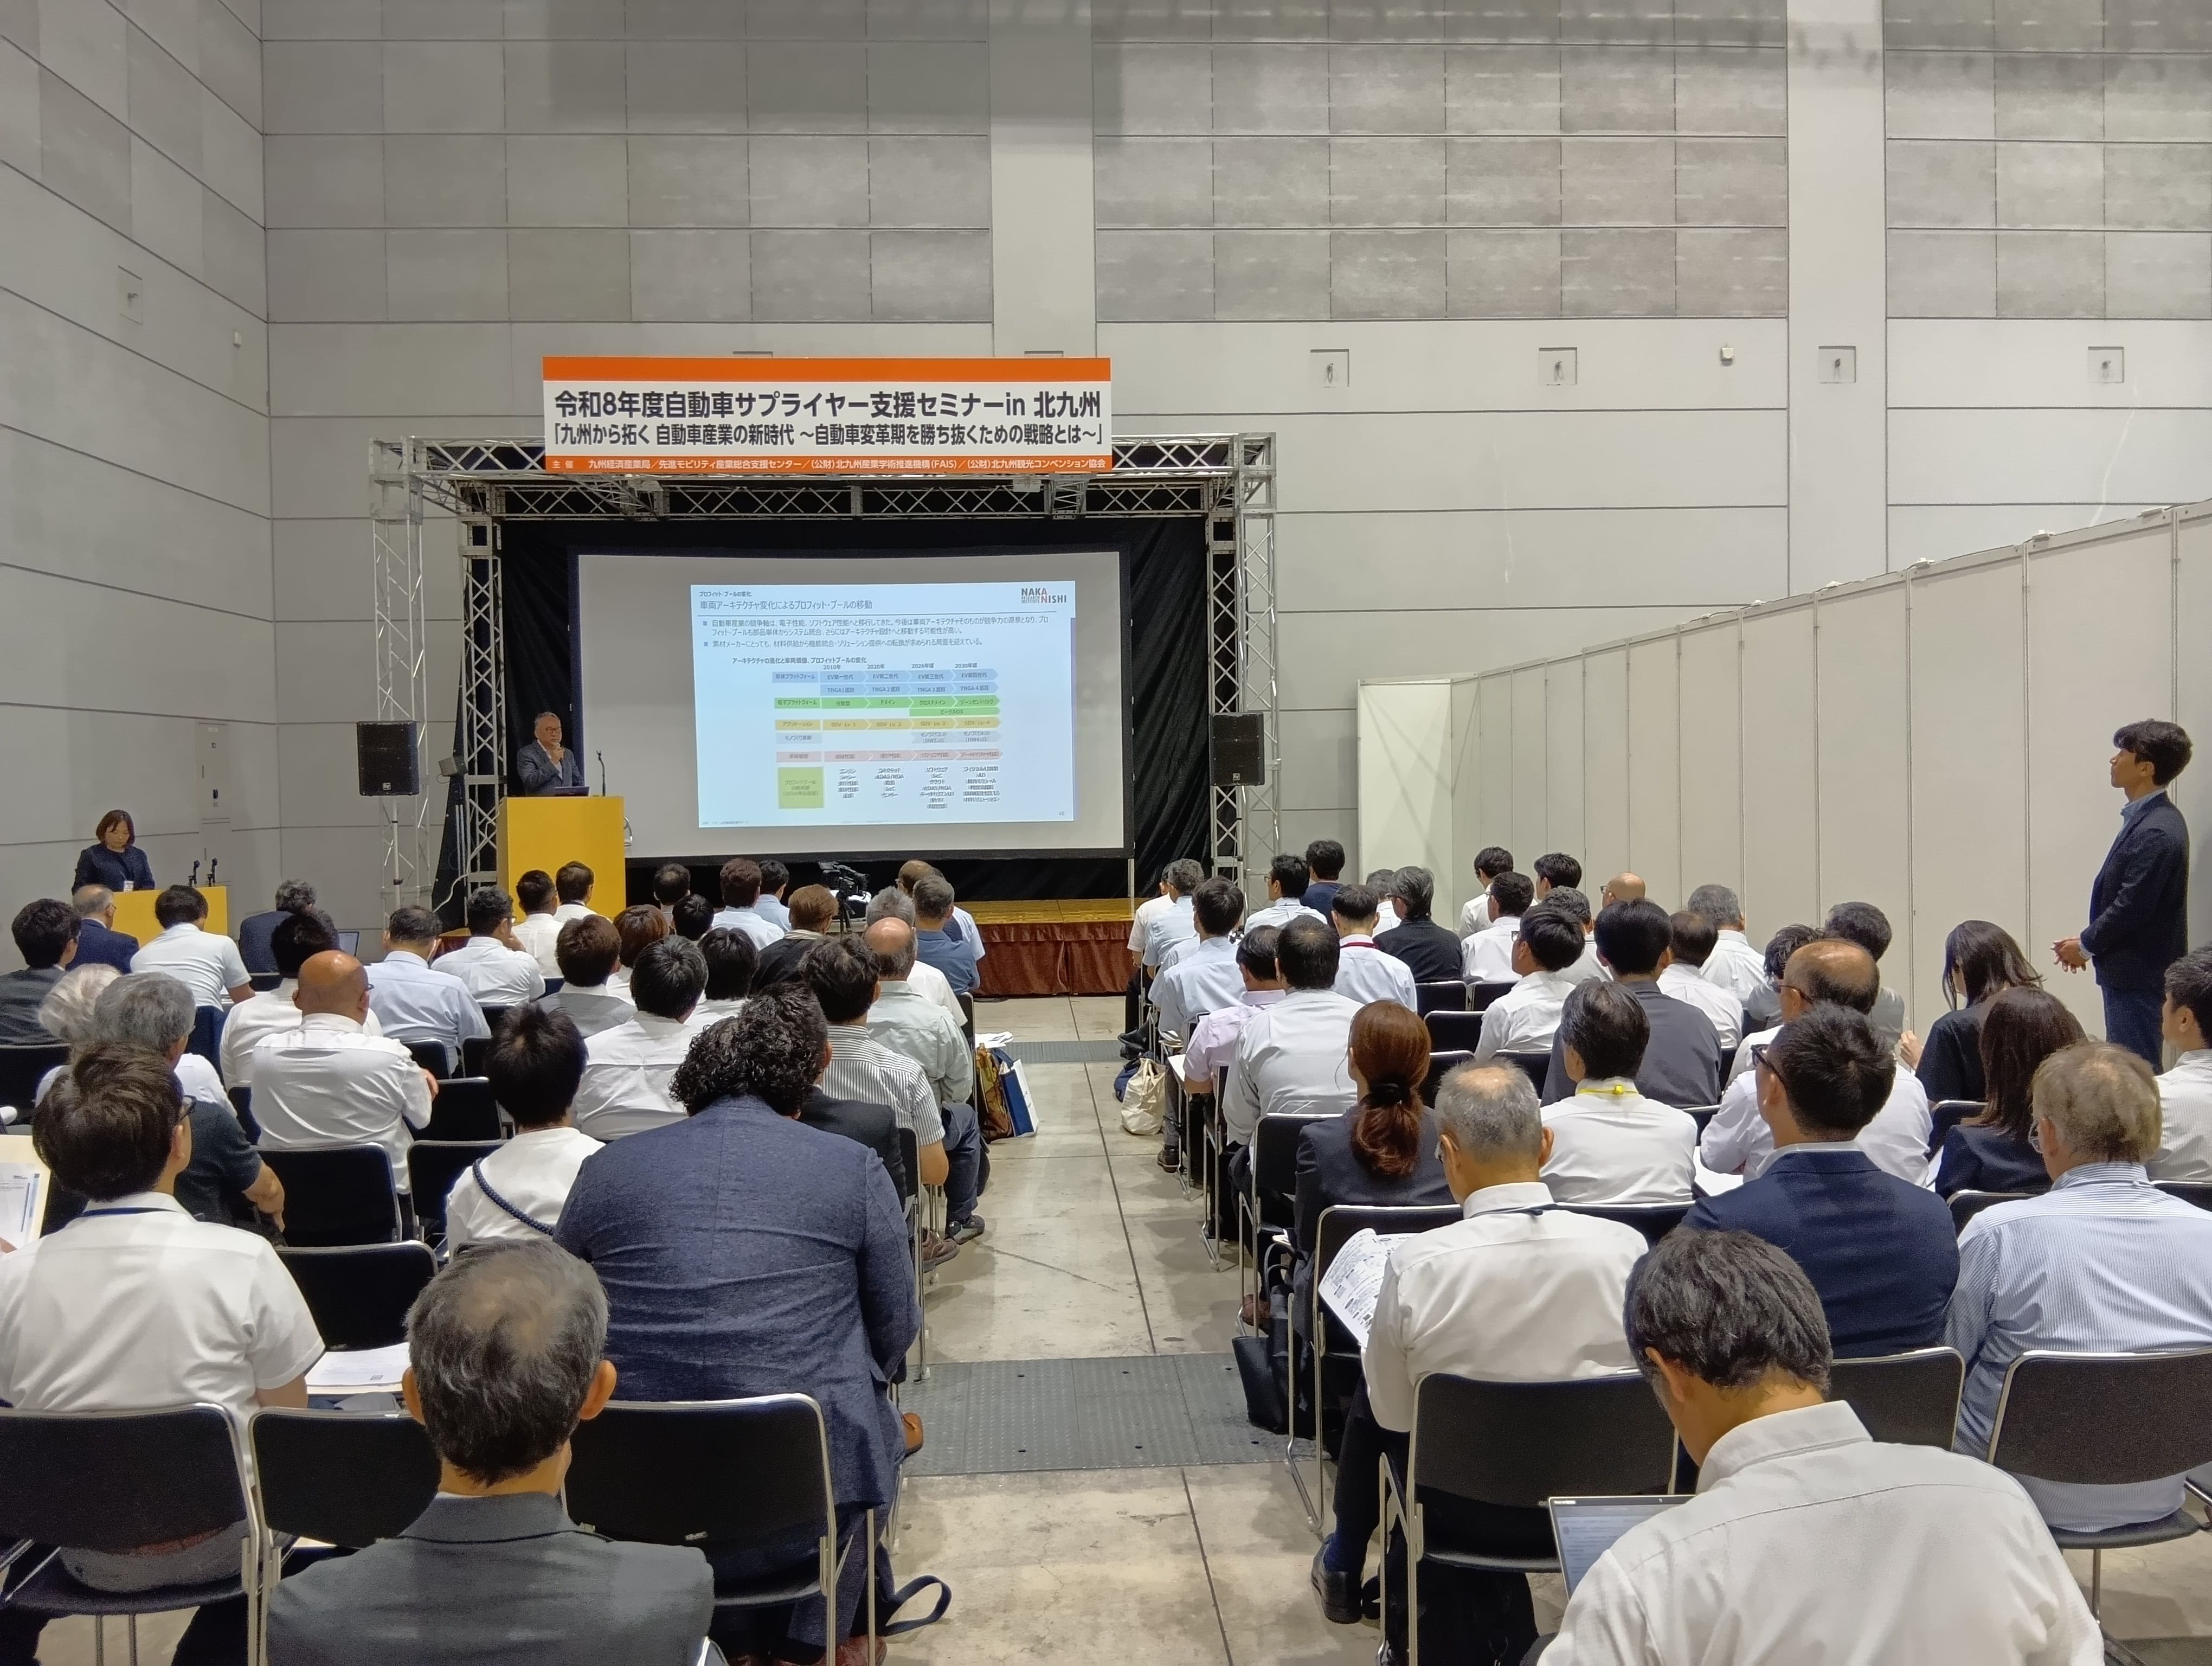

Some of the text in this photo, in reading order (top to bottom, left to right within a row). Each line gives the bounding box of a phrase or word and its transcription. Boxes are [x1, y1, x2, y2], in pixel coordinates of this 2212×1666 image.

[555, 390, 1101, 419] 令和8年度自動車サプライヤー支援セミナーin 北九州
[555, 422, 650, 445] 「九州から拓く
[657, 424, 794, 445] 自動車産業の新時代
[1041, 595, 1066, 603] NISHI
